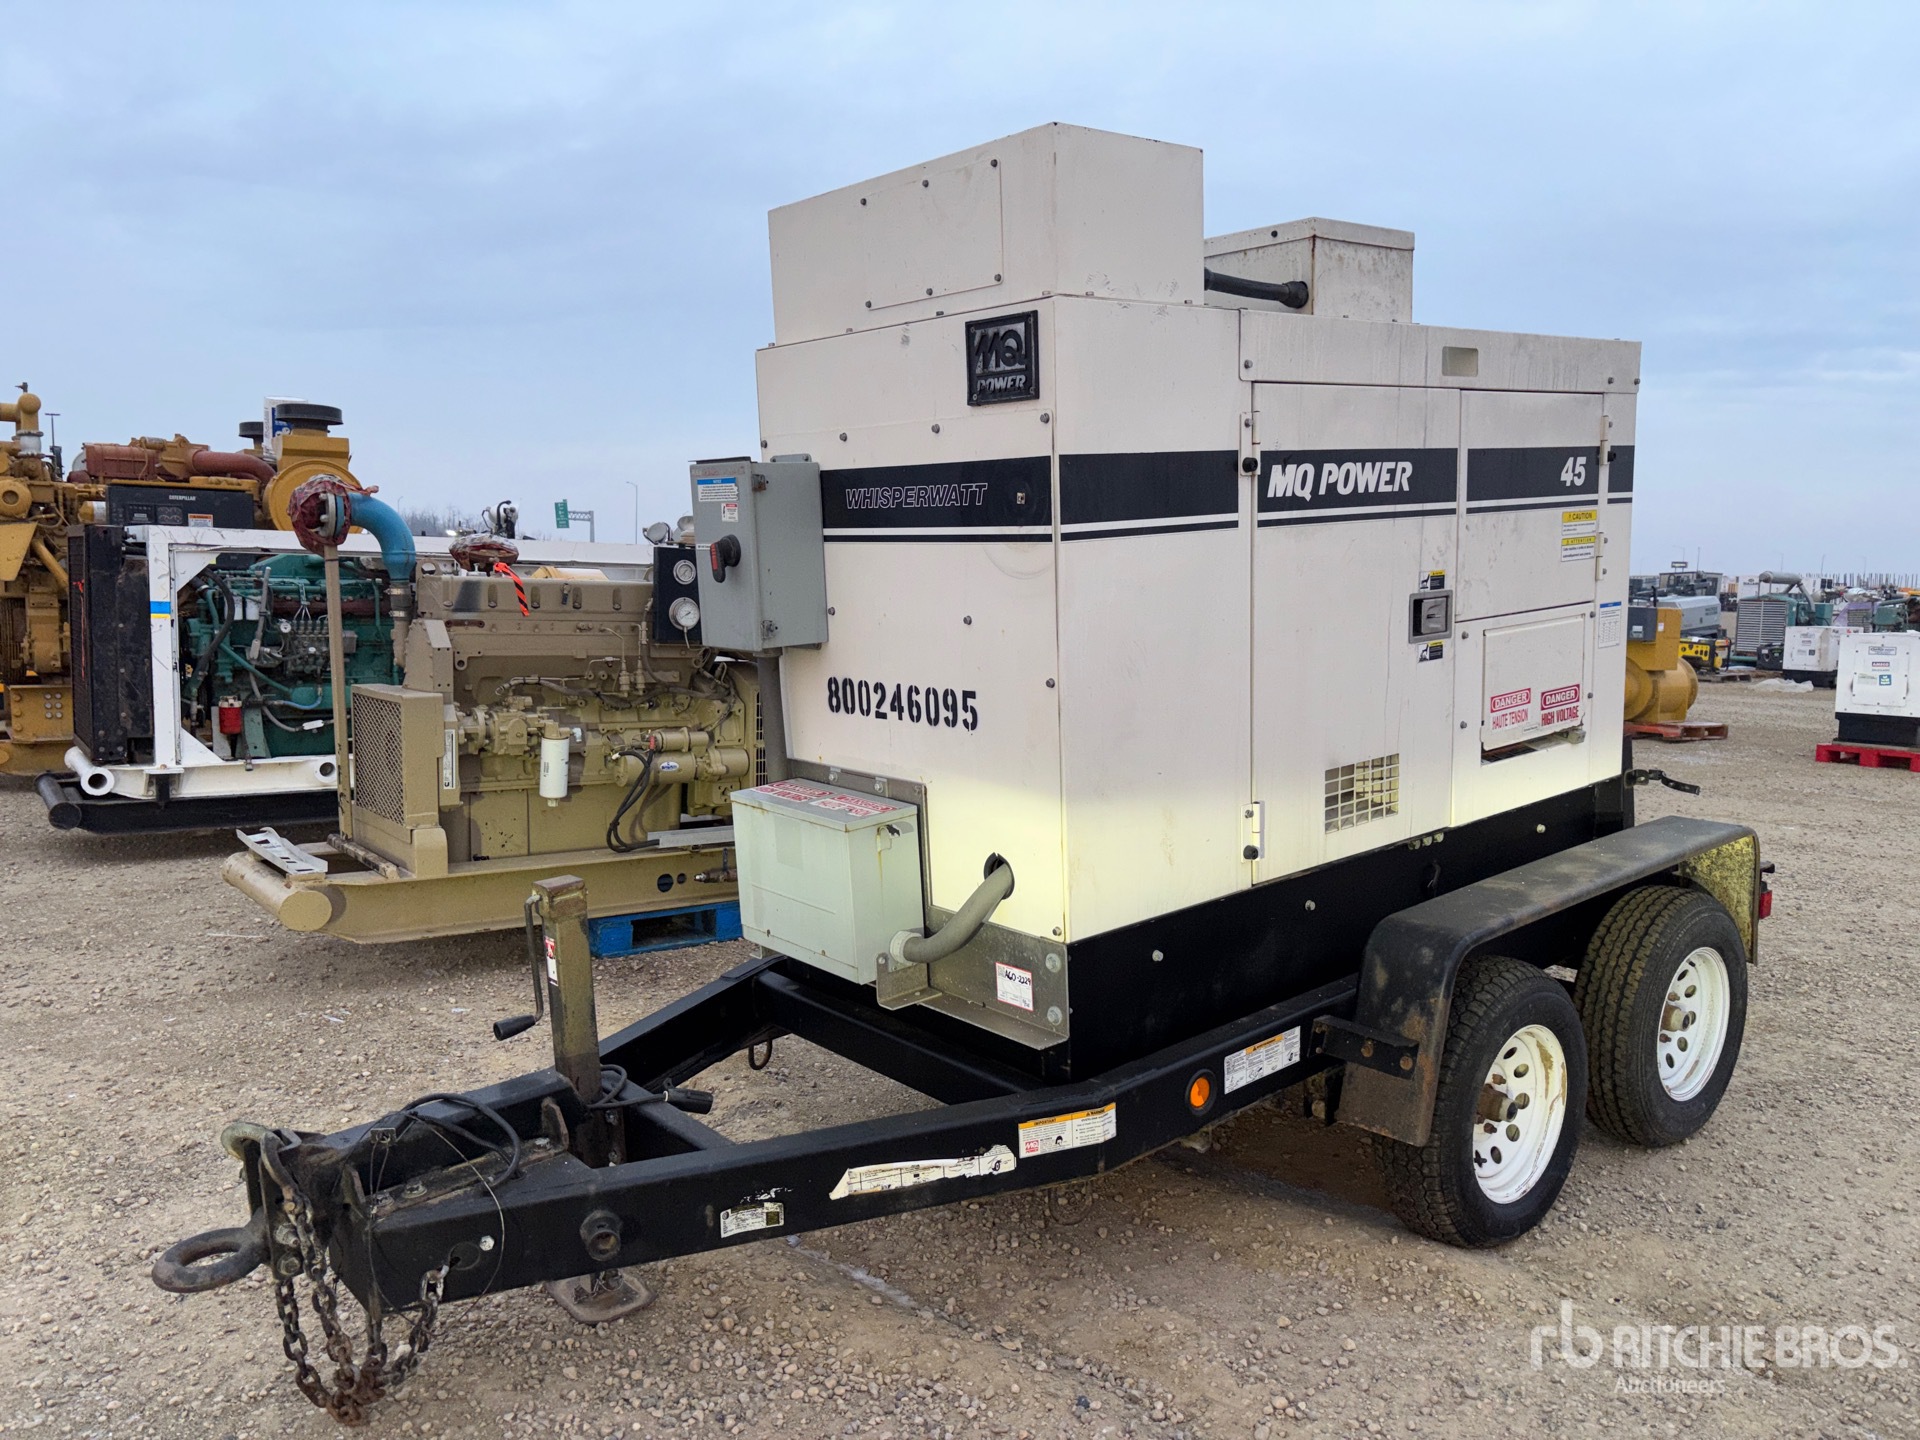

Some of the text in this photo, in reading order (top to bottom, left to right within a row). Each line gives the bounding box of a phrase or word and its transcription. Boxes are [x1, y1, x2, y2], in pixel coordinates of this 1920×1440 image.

[973, 321, 1026, 374] MQ
[976, 374, 1027, 392] POWER
[1266, 461, 1413, 502] MQ POWER
[1560, 456, 1587, 487] 45
[845, 482, 988, 510] WHISPERWATT
[1571, 512, 1593, 520] CAUTION
[827, 676, 979, 732] 800246095
[1494, 692, 1528, 709] DANGER
[1545, 689, 1576, 705] DANGER
[1492, 713, 1508, 730] HAUTE
[1508, 709, 1529, 725] TENSION
[1541, 705, 1579, 727] HIGH VOLTAGE
[1033, 1118, 1057, 1126] IMPORTANT
